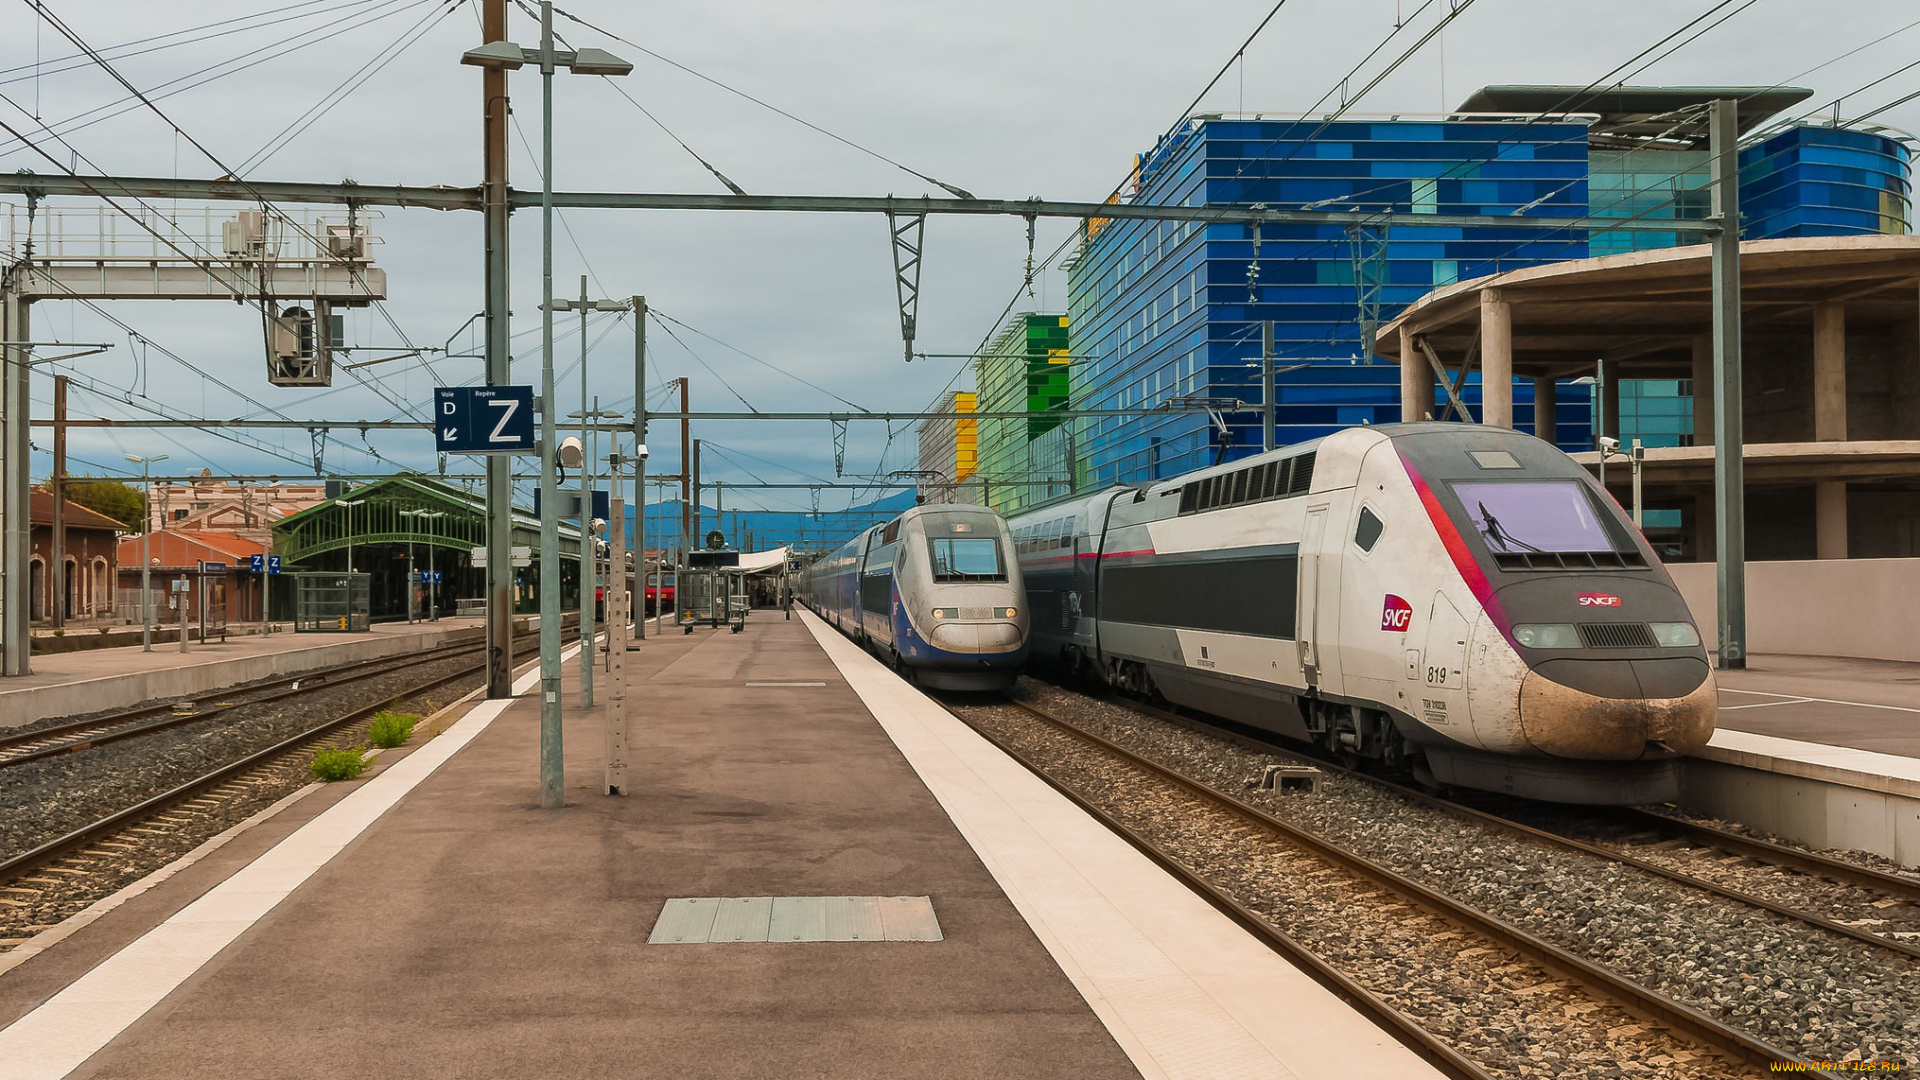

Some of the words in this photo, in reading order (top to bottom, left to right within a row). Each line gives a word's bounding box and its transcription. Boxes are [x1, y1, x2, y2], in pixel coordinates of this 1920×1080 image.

[475, 390, 496, 398] Repère
[443, 402, 456, 415] D
[488, 400, 521, 442] Z
[253, 556, 261, 566] Z
[271, 557, 279, 567] Z
[1578, 596, 1619, 605] SNCF
[1382, 608, 1412, 627] SNCF
[1427, 666, 1447, 684] 819
